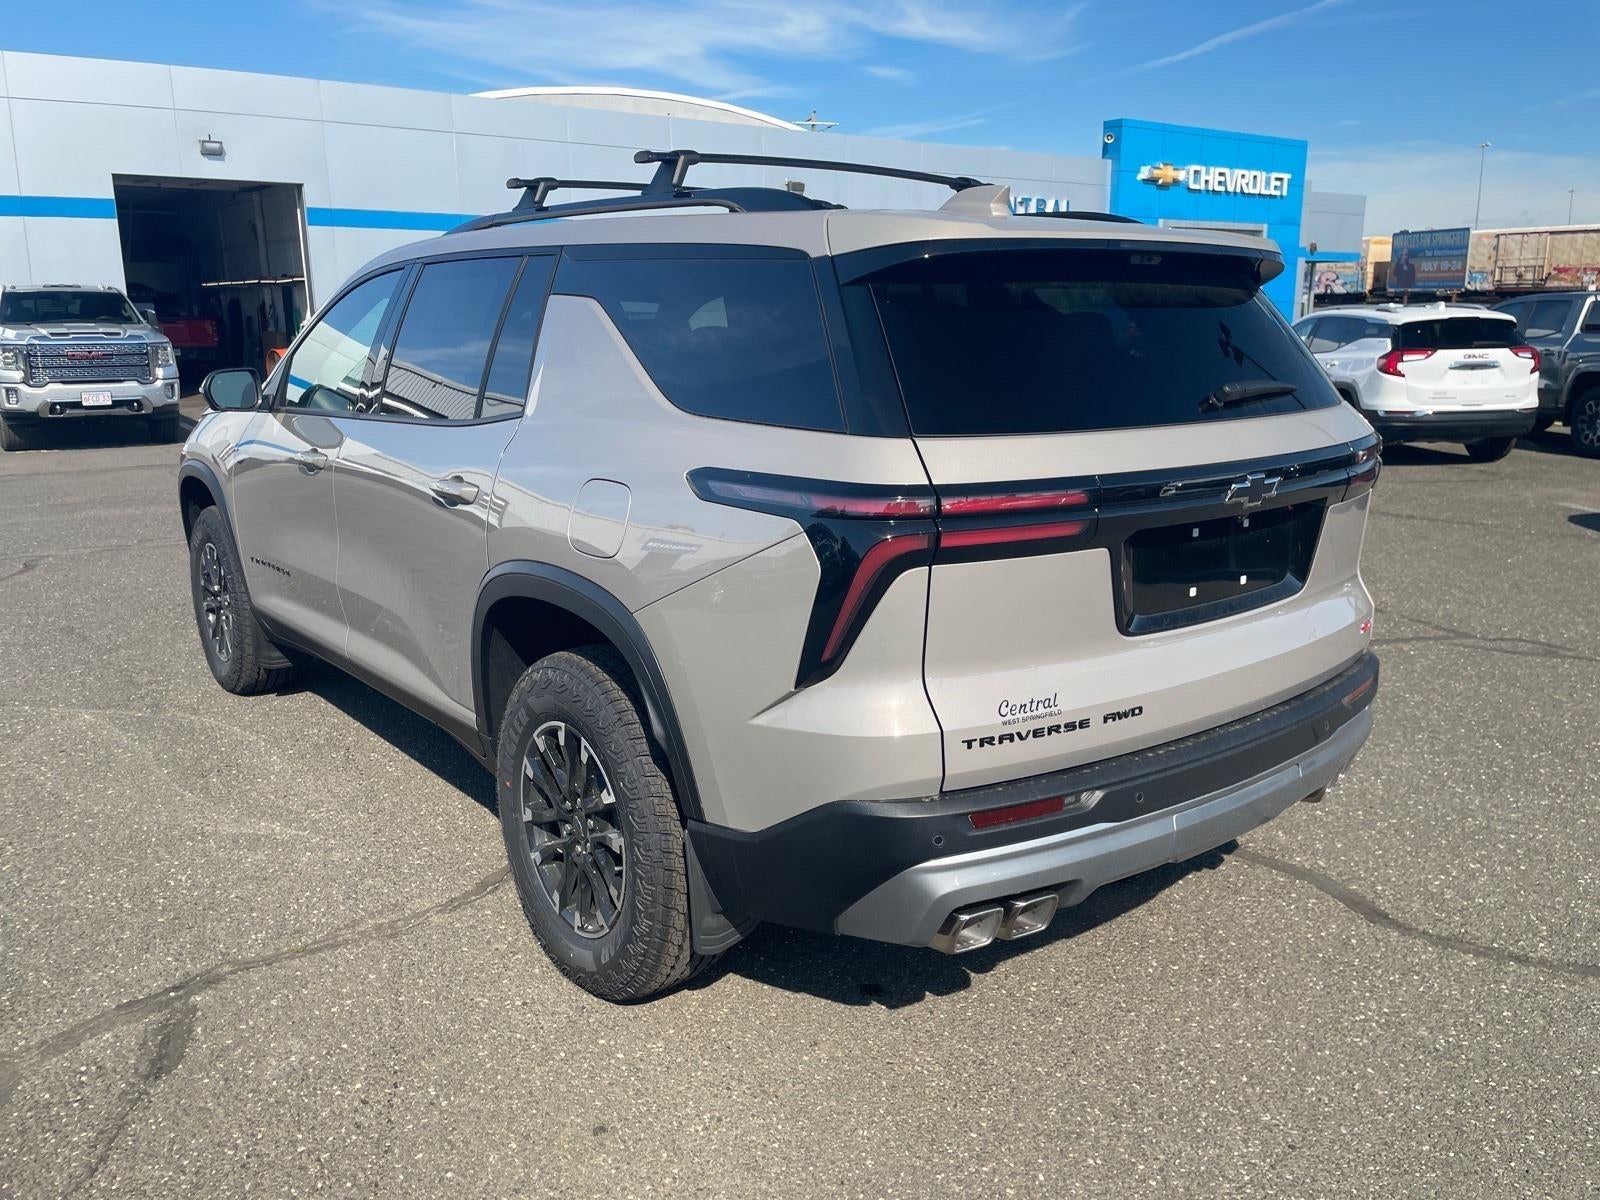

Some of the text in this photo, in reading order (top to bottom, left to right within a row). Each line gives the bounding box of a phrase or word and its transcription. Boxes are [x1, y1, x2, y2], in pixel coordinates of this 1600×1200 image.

[1187, 164, 1292, 197] CHEVROLET
[67, 351, 113, 360] GMC
[998, 692, 1060, 718] Central
[1001, 708, 1062, 726] WEST SPRINGFIELD
[962, 705, 1144, 751] TRAVERSE AWD
